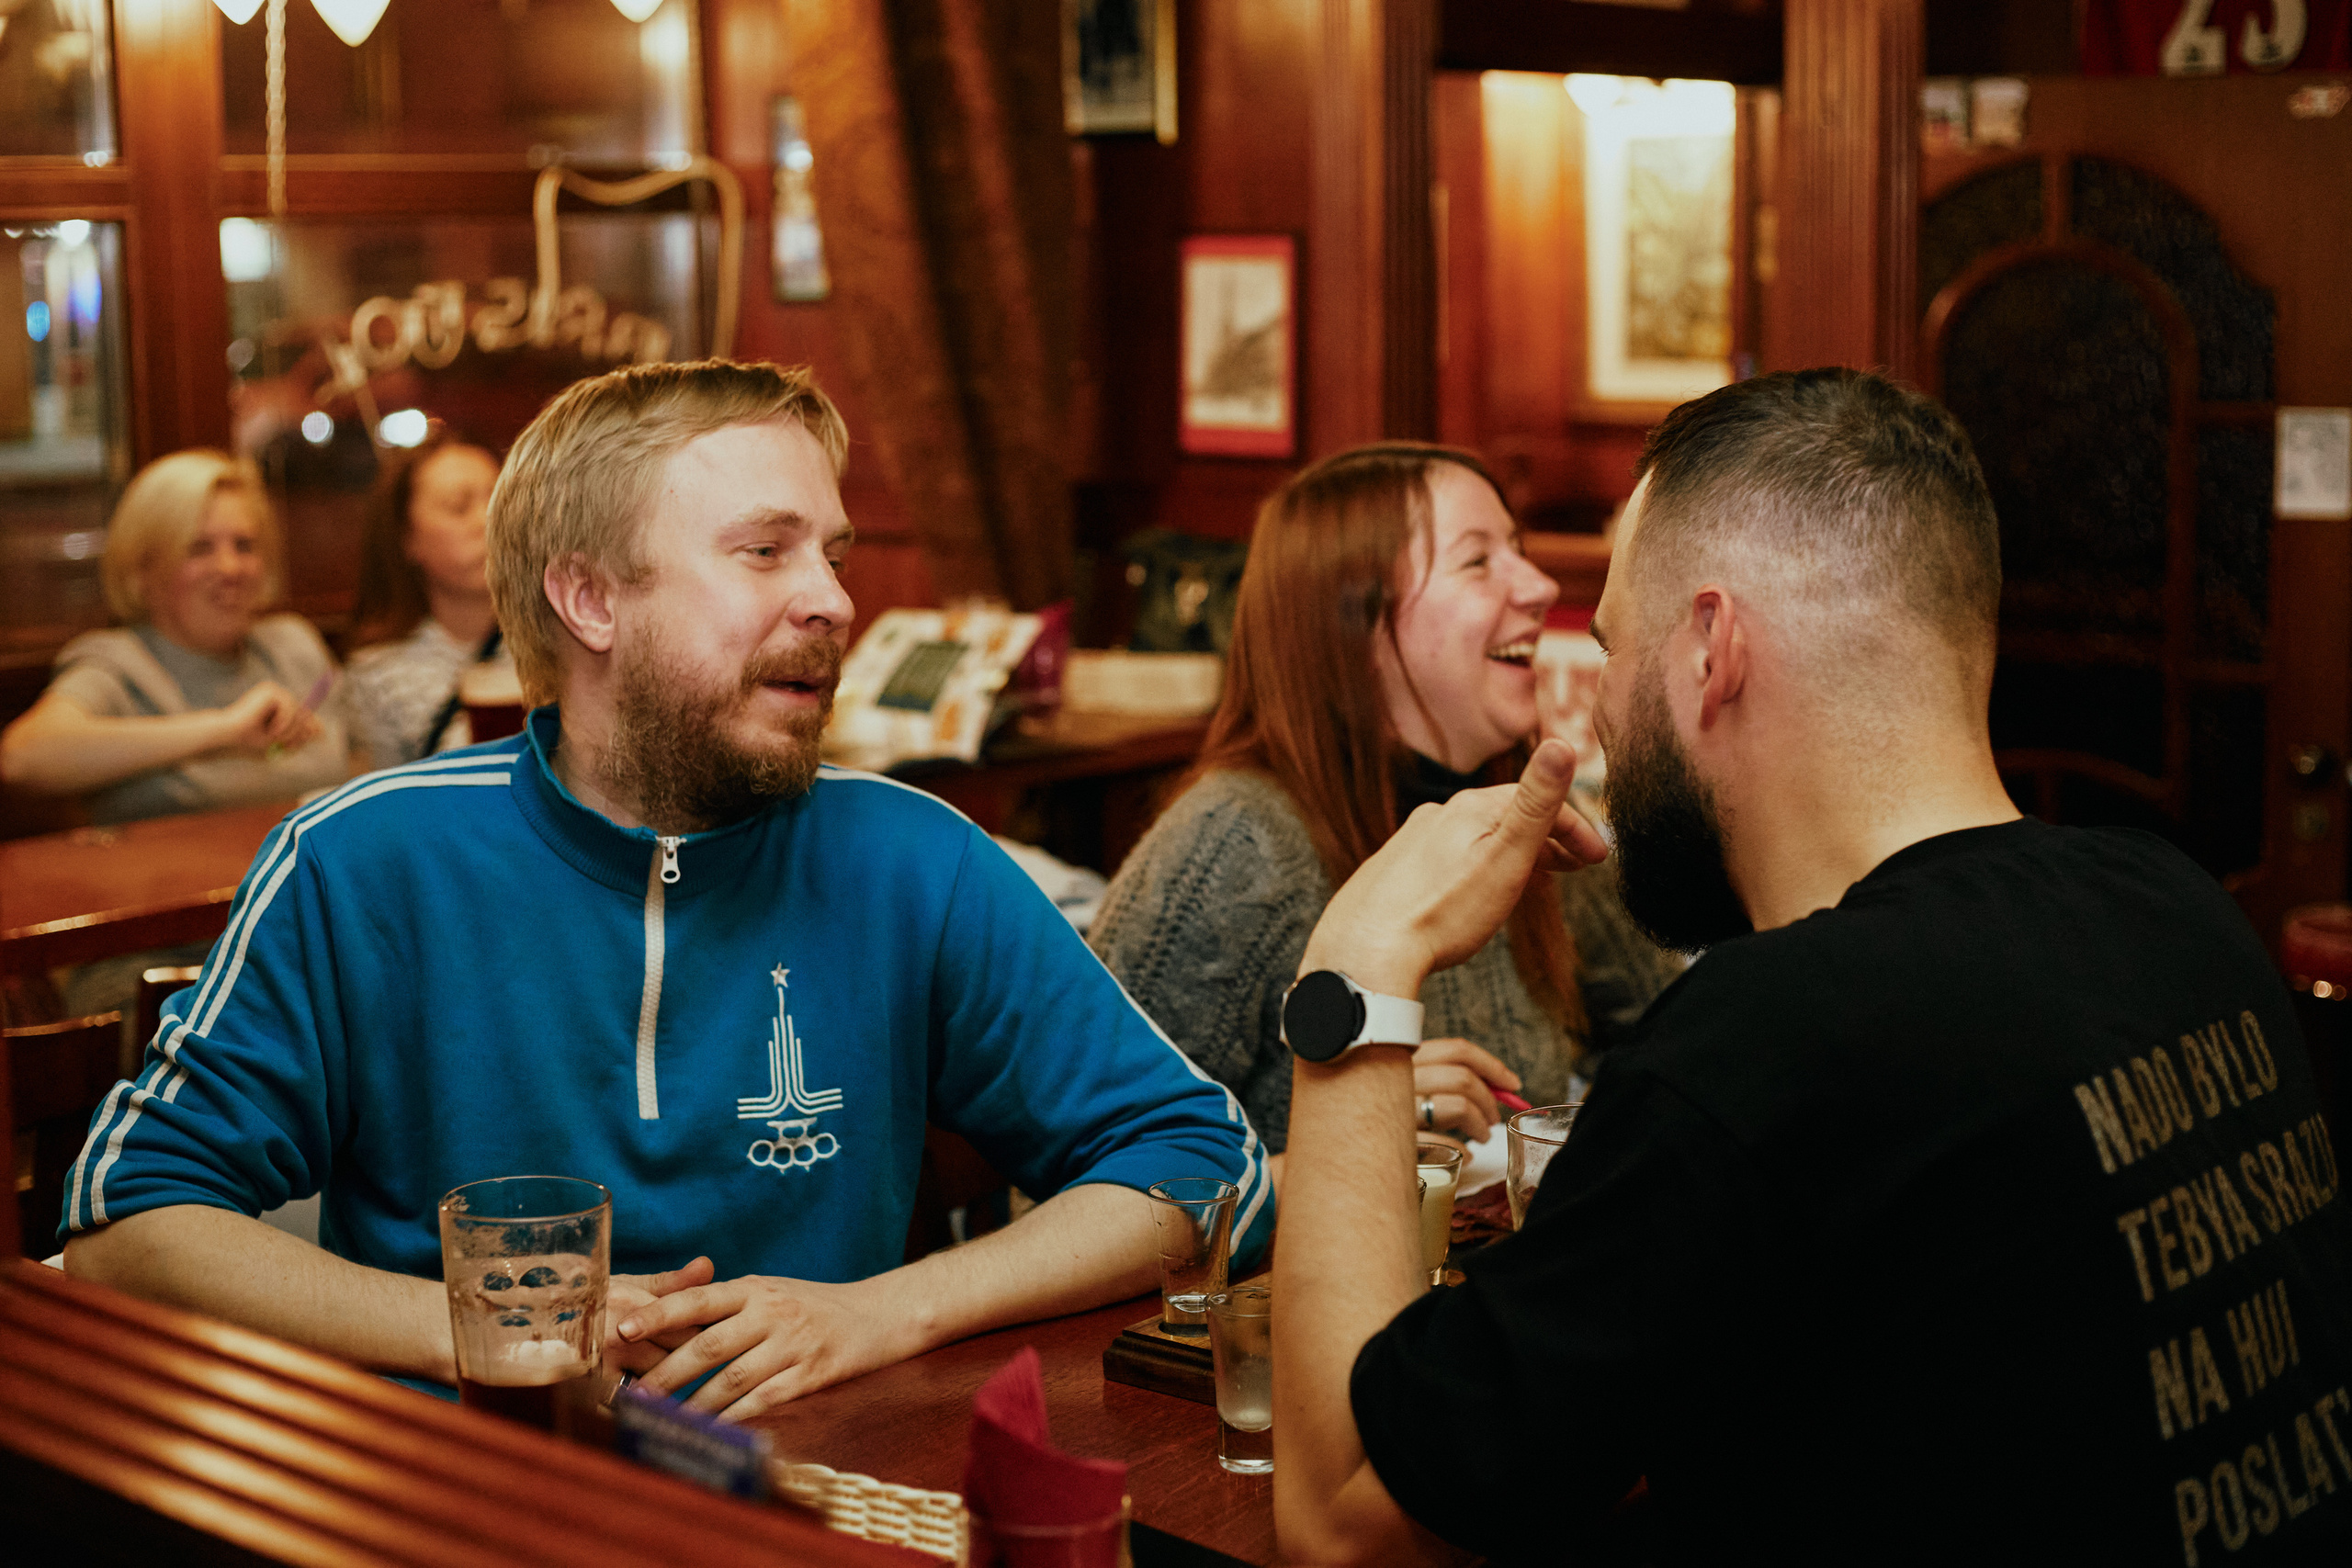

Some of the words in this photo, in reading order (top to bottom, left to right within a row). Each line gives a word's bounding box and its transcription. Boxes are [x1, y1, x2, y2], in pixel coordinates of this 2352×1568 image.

[2073, 1045, 2194, 1174] NADO
[2180, 1010, 2278, 1119] BYLO
[2117, 1165, 2262, 1303] TEBYA
[2239, 1112, 2340, 1235] SRAZU
[2148, 1326, 2231, 1441] NA
[2226, 1279, 2301, 1398] HUI
